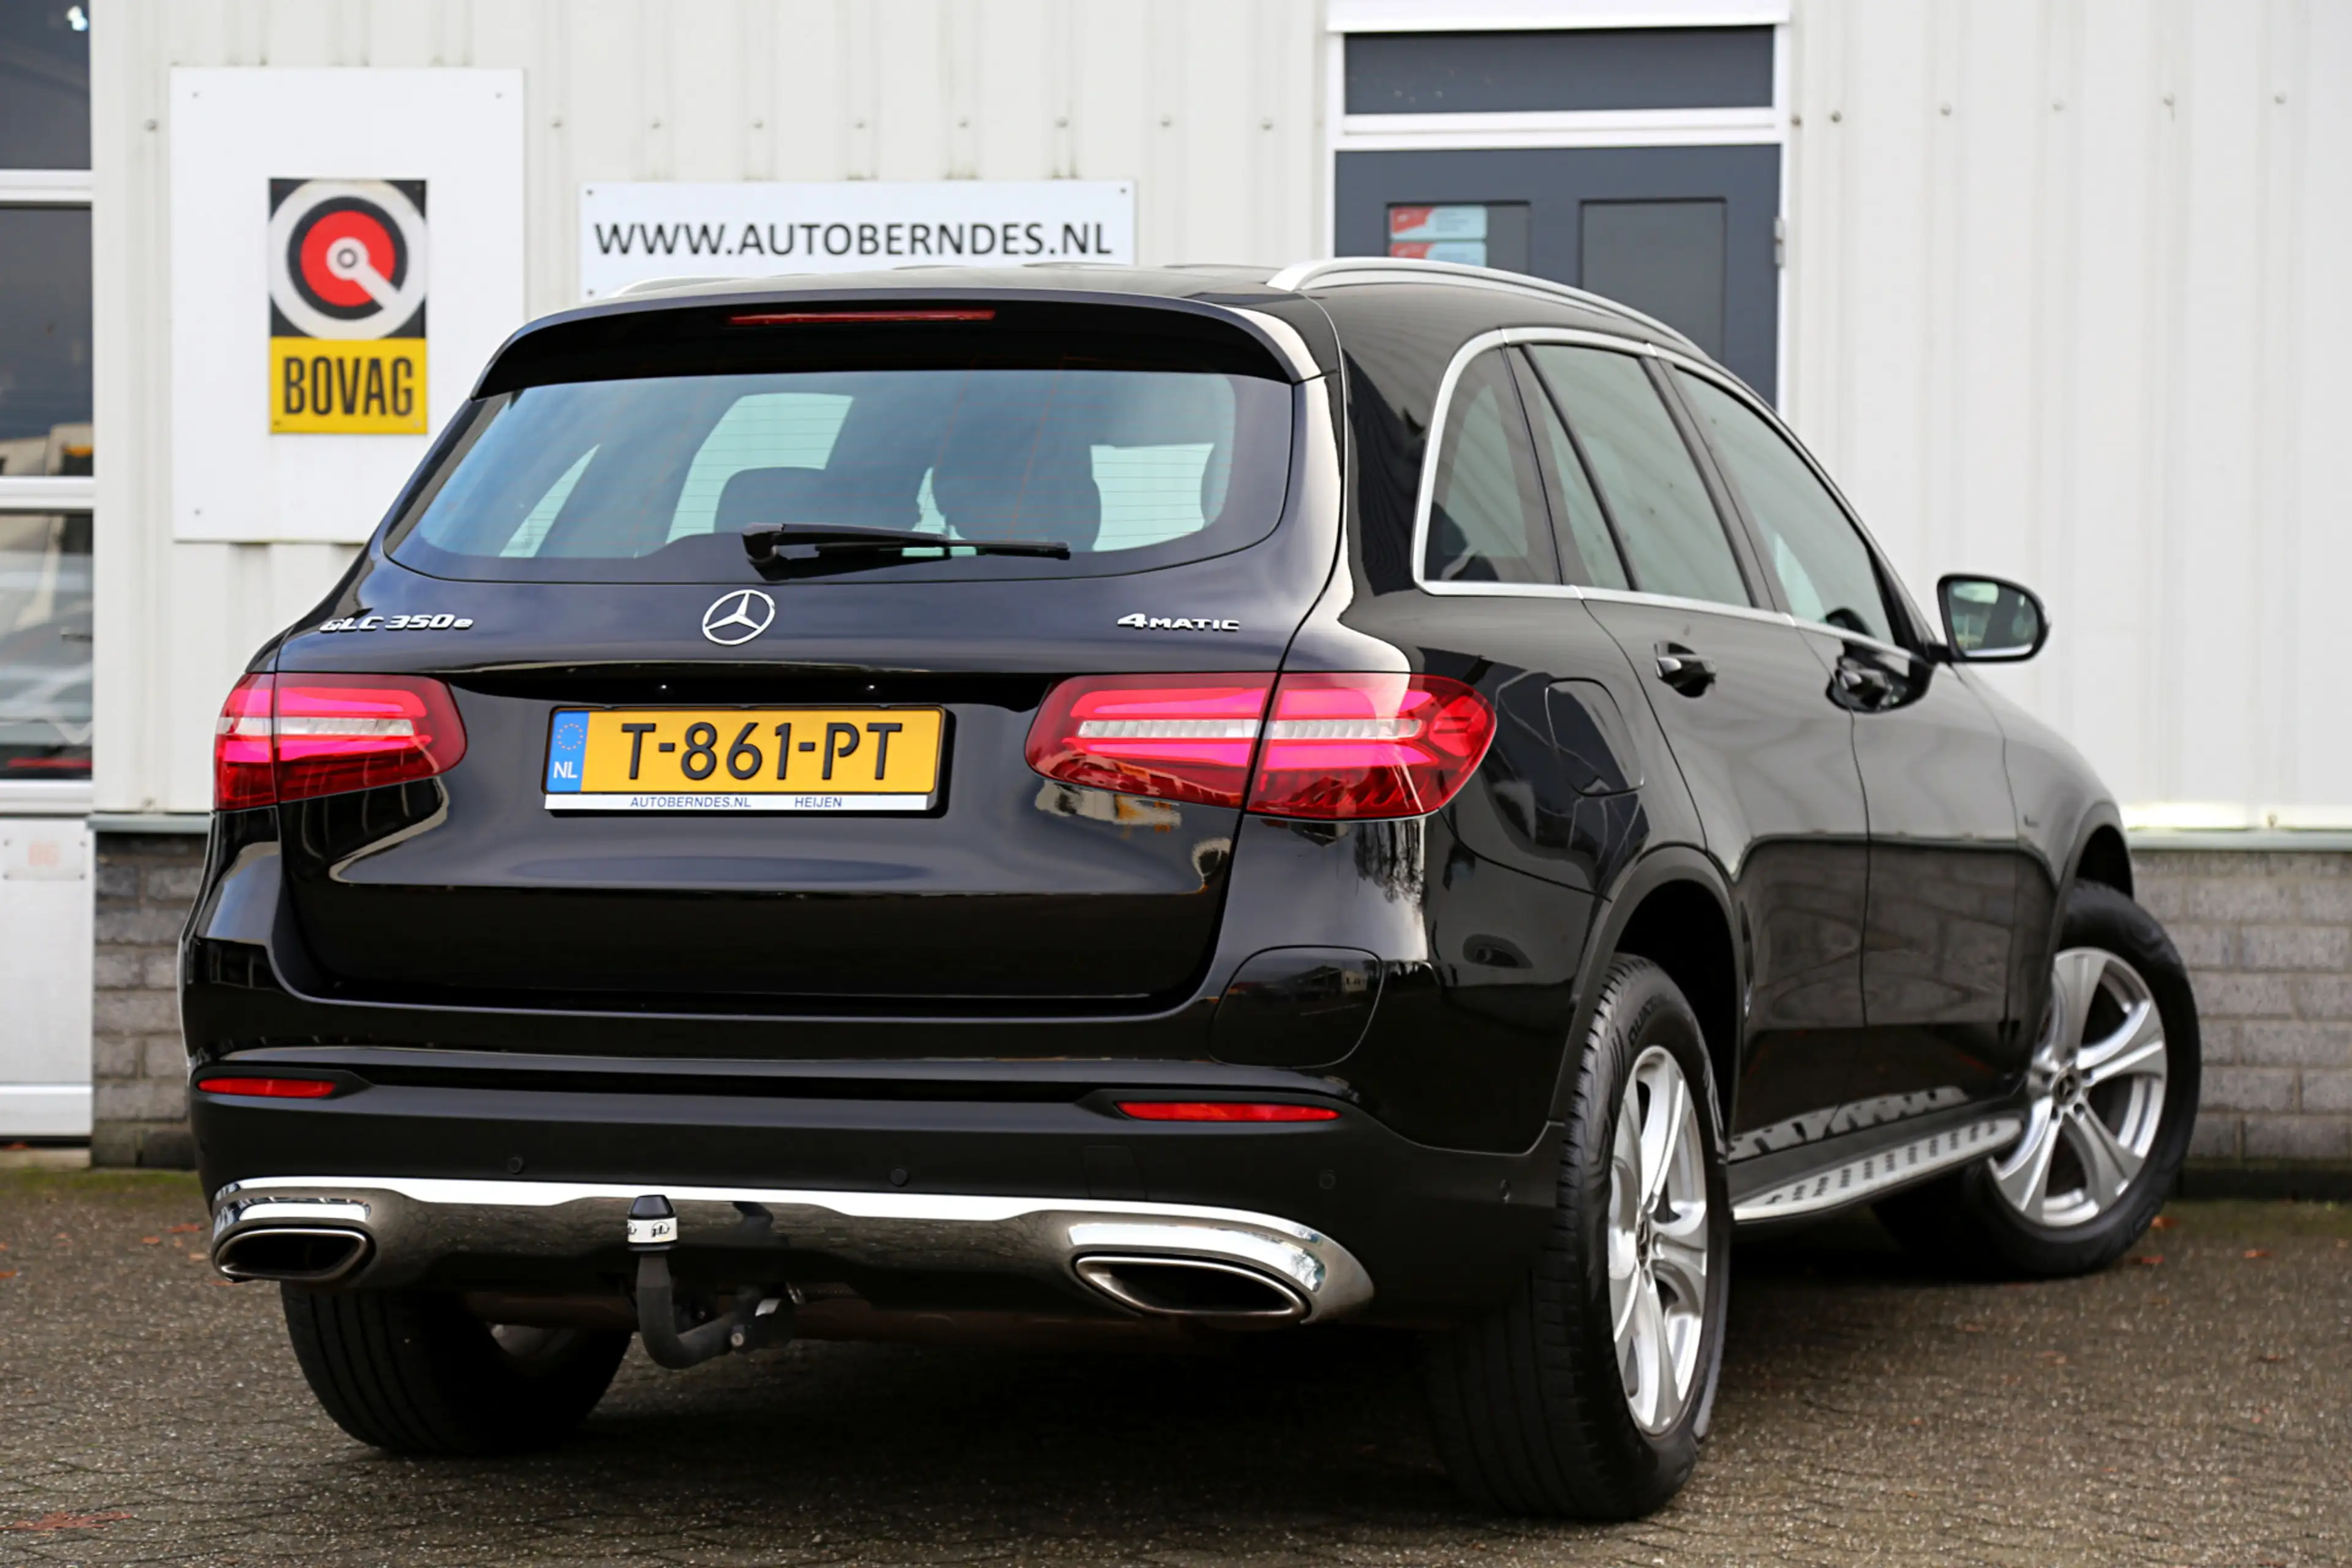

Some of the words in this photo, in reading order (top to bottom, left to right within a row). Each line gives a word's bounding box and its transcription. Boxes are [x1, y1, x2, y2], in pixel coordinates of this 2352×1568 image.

[594, 221, 1112, 257] WWW.AUTOBERNDES.NL
[283, 355, 413, 417] BOVAG
[319, 616, 384, 632] GLC
[385, 614, 474, 630] 350e
[1117, 613, 1240, 631] 4MATIC
[620, 721, 903, 781] T-861-PT
[552, 761, 579, 780] NL
[630, 796, 752, 809] AUTOBERNDES.NL
[794, 796, 843, 809] HEIJEN
